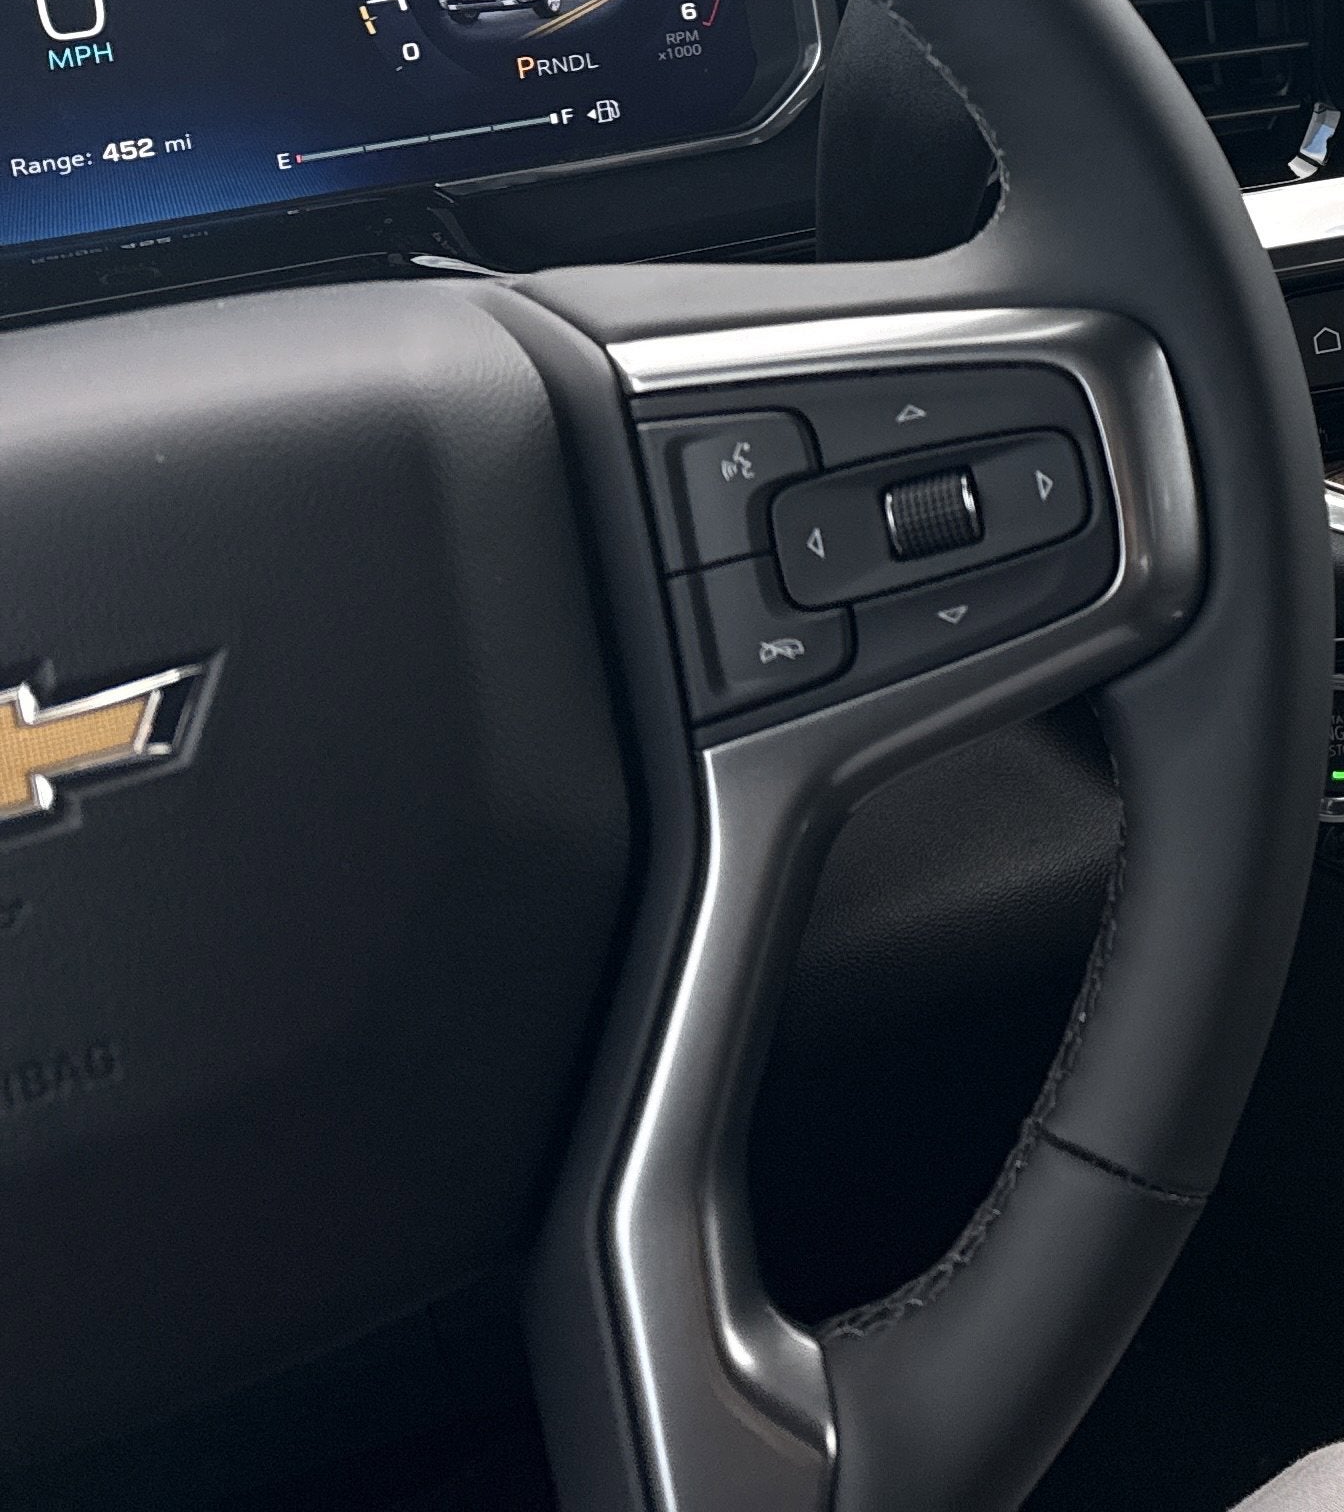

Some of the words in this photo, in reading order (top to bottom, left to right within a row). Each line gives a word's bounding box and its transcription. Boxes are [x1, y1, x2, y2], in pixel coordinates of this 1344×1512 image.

[681, 3, 697, 20] 6
[665, 30, 699, 46] RPM
[48, 42, 114, 70] MPH
[402, 43, 420, 62] 0
[658, 44, 702, 62] x1000
[561, 108, 575, 125] F
[10, 151, 93, 177] Range:
[102, 137, 155, 162] 452
[164, 133, 192, 154] mi
[277, 152, 292, 170] E
